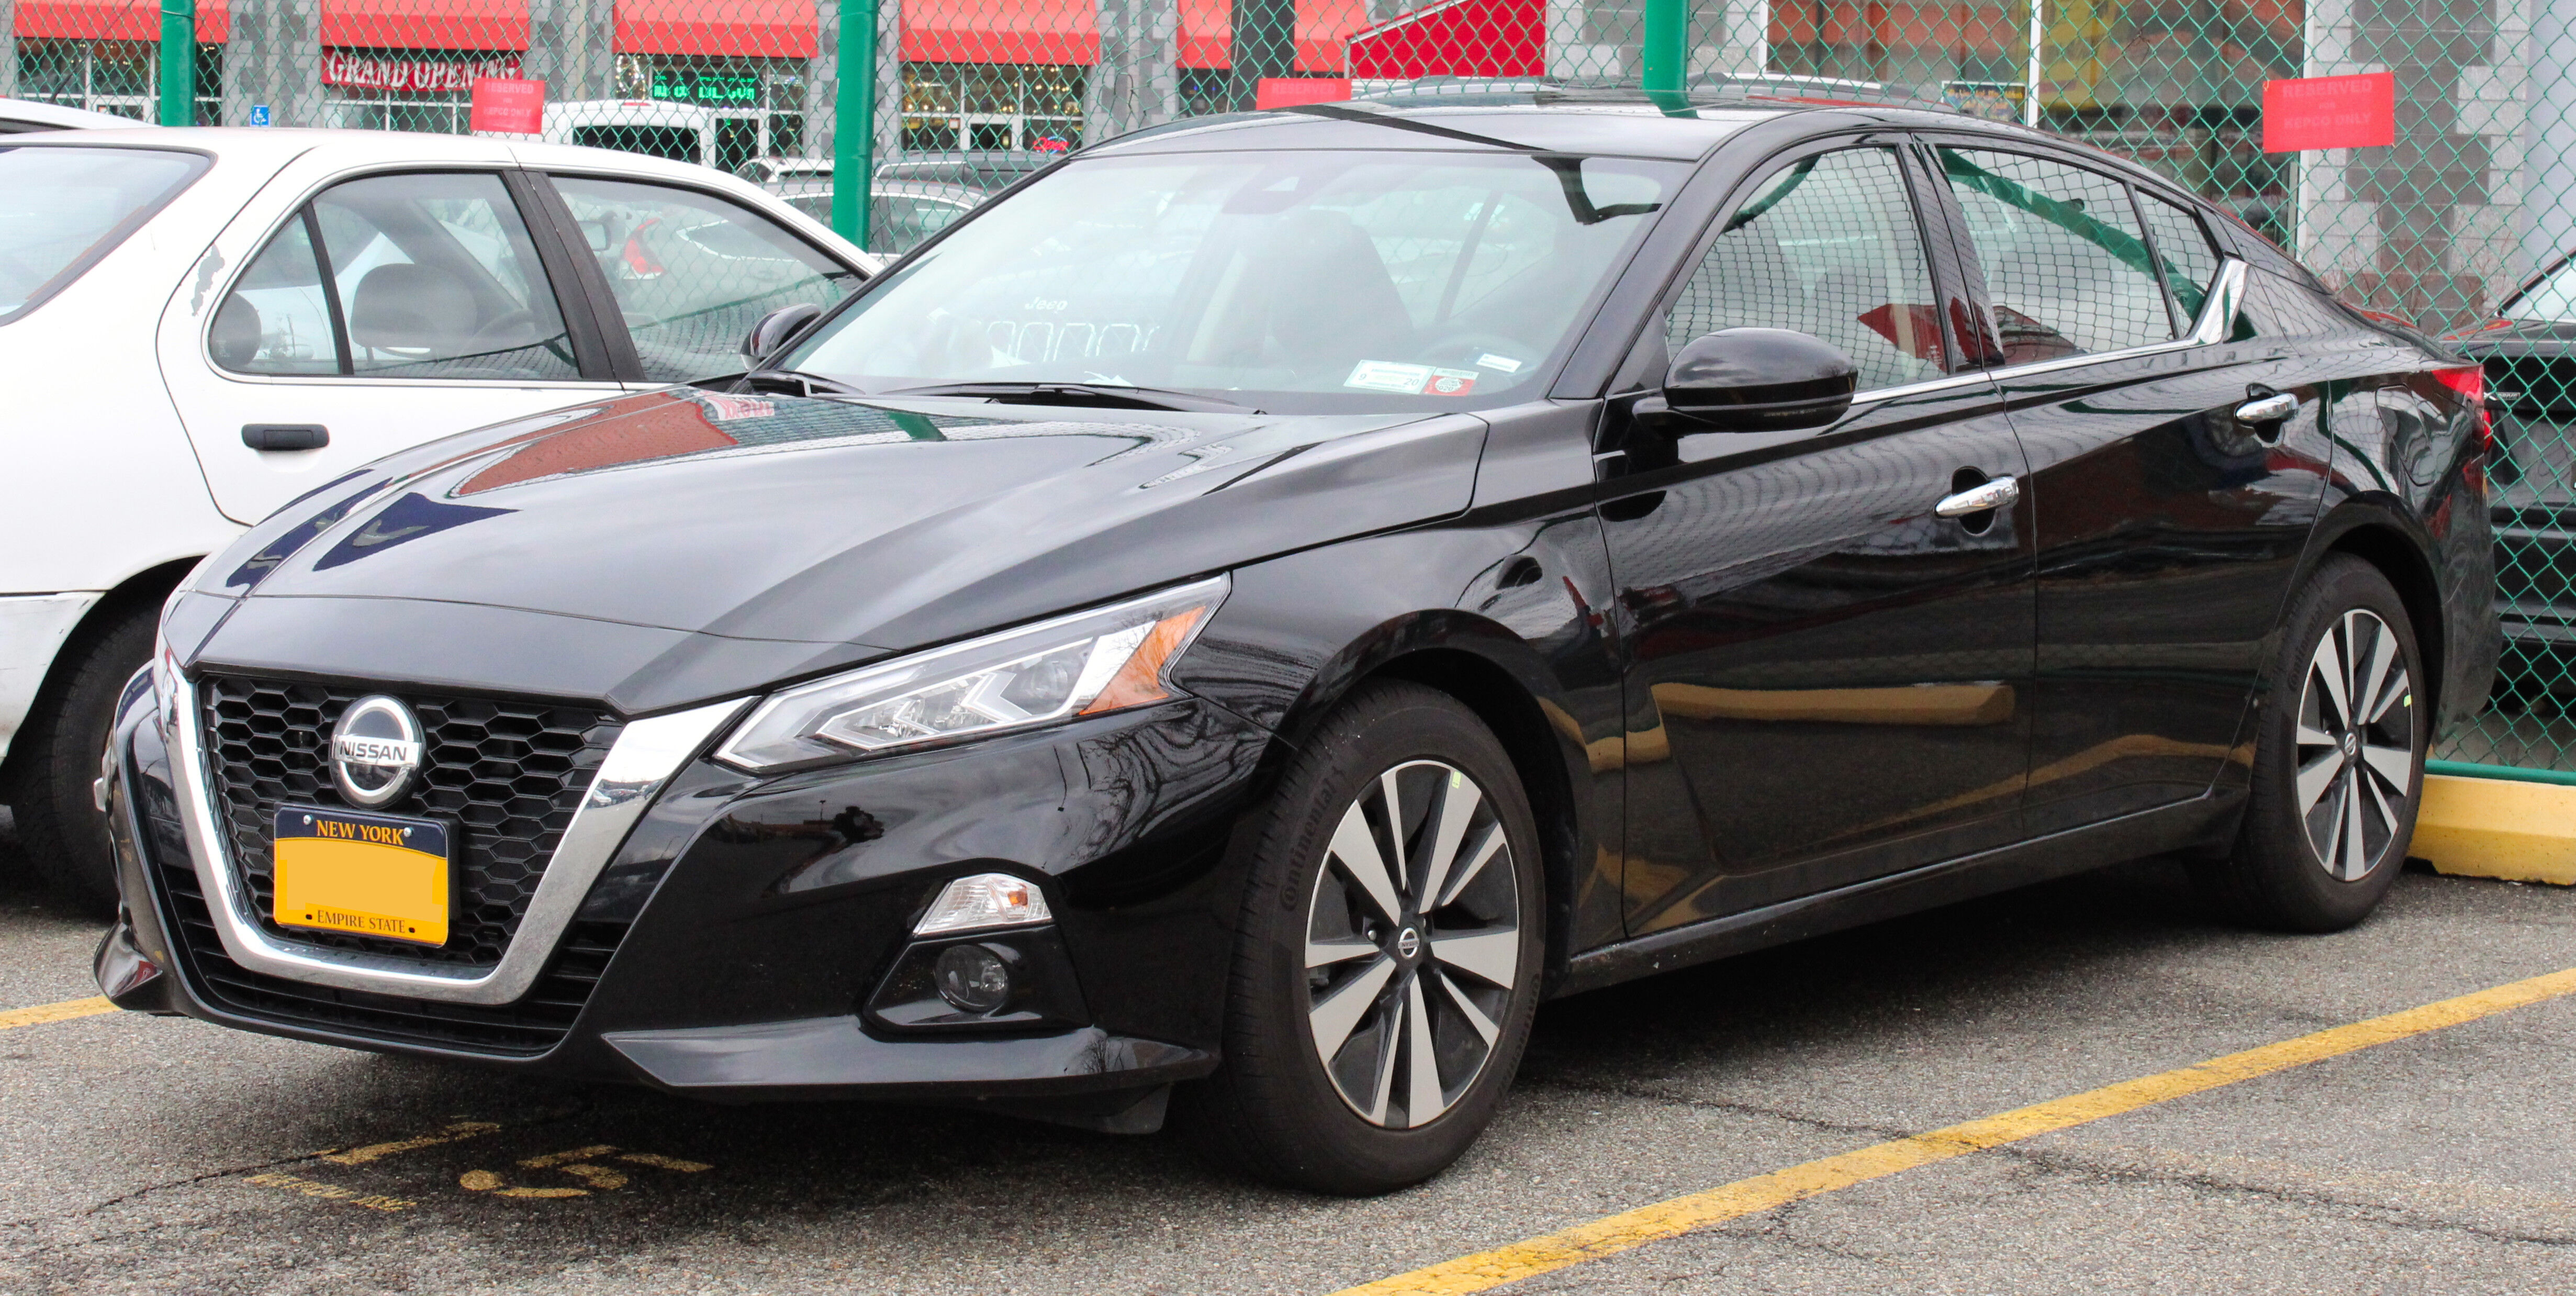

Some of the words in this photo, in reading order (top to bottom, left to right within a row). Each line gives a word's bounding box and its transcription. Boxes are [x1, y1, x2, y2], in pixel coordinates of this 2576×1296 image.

[328, 53, 409, 87] GRAND
[484, 82, 534, 94] RESERVED
[1272, 83, 1336, 95] RESERVED
[2283, 79, 2372, 98] RESERVED
[2335, 111, 2372, 126] ONLY
[1025, 296, 1068, 313] Jeep
[339, 739, 408, 762] NISSAN
[316, 820, 355, 839] NEW
[359, 824, 404, 846] YORK
[317, 910, 364, 929] EMPIRE
[369, 917, 406, 933] STATE
